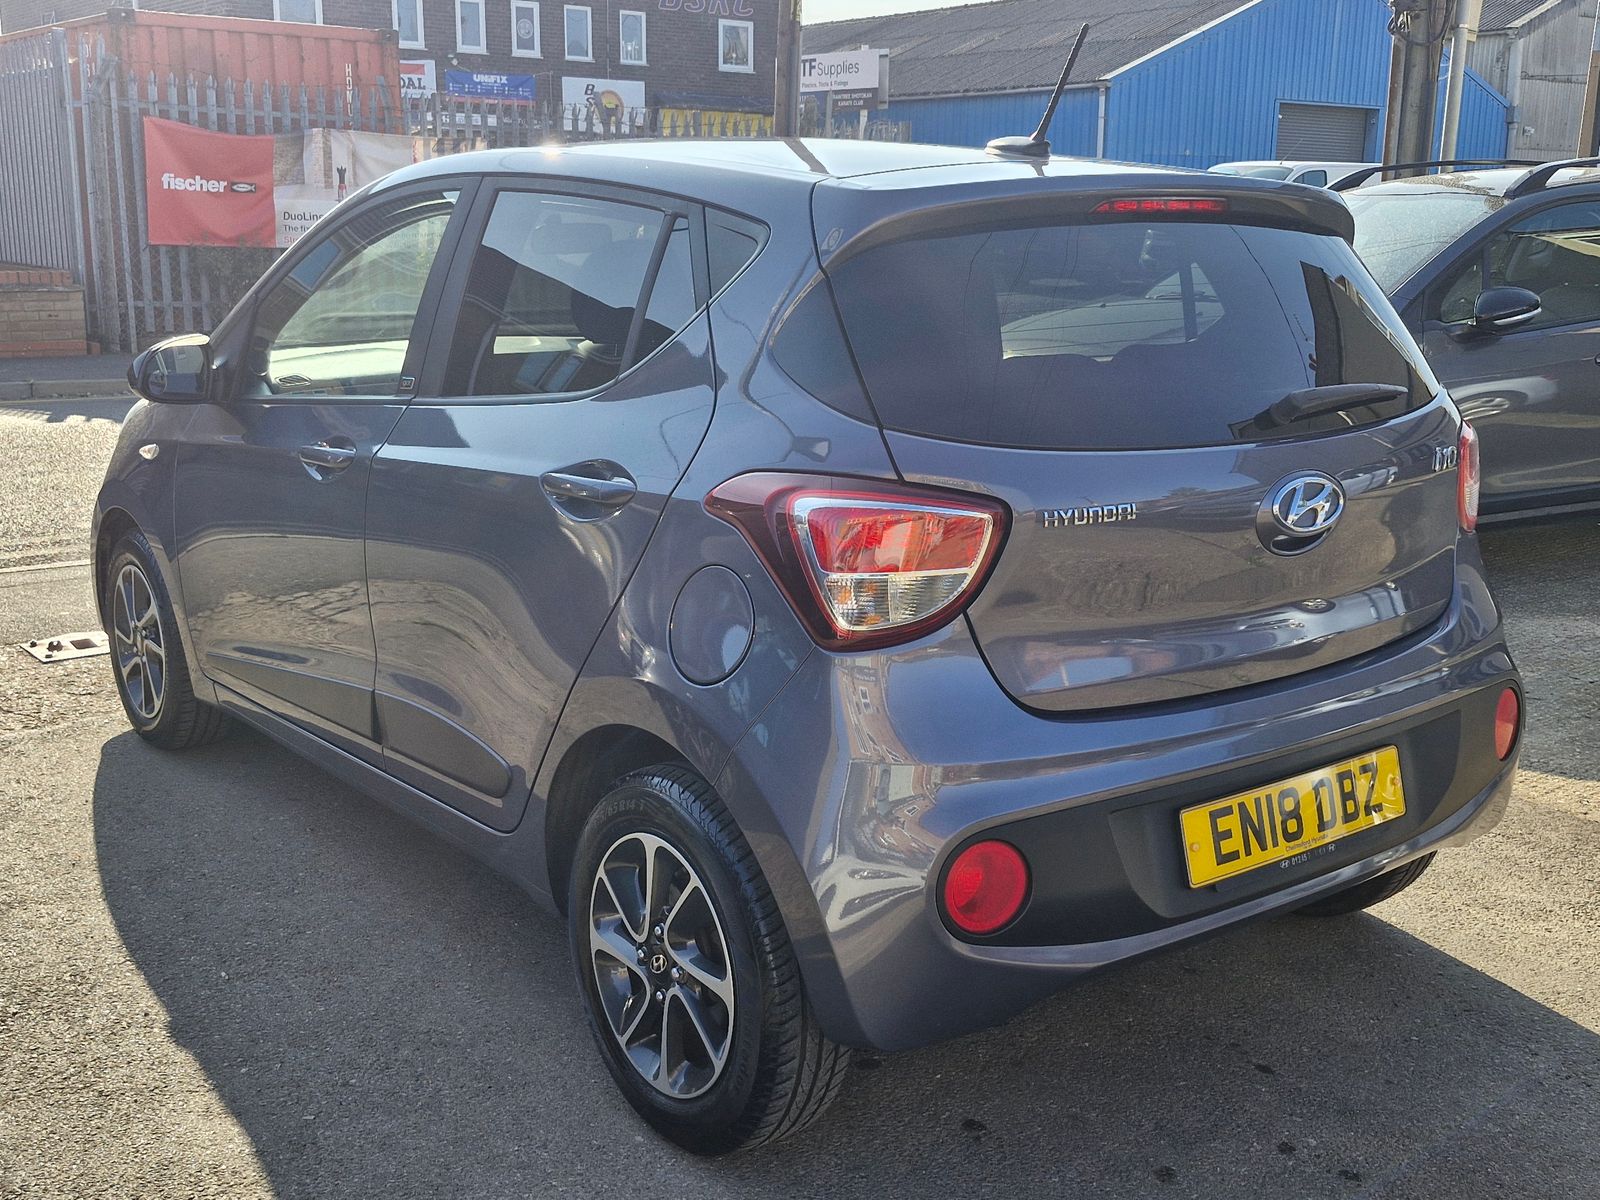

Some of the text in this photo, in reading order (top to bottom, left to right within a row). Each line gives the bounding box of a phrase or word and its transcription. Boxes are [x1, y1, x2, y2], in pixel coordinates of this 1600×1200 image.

[817, 61, 859, 78] Supplies
[162, 172, 227, 192] fischer
[283, 224, 299, 232] The
[1043, 503, 1137, 528] HYUNDAI
[1208, 761, 1384, 866] EN18 DBZ
